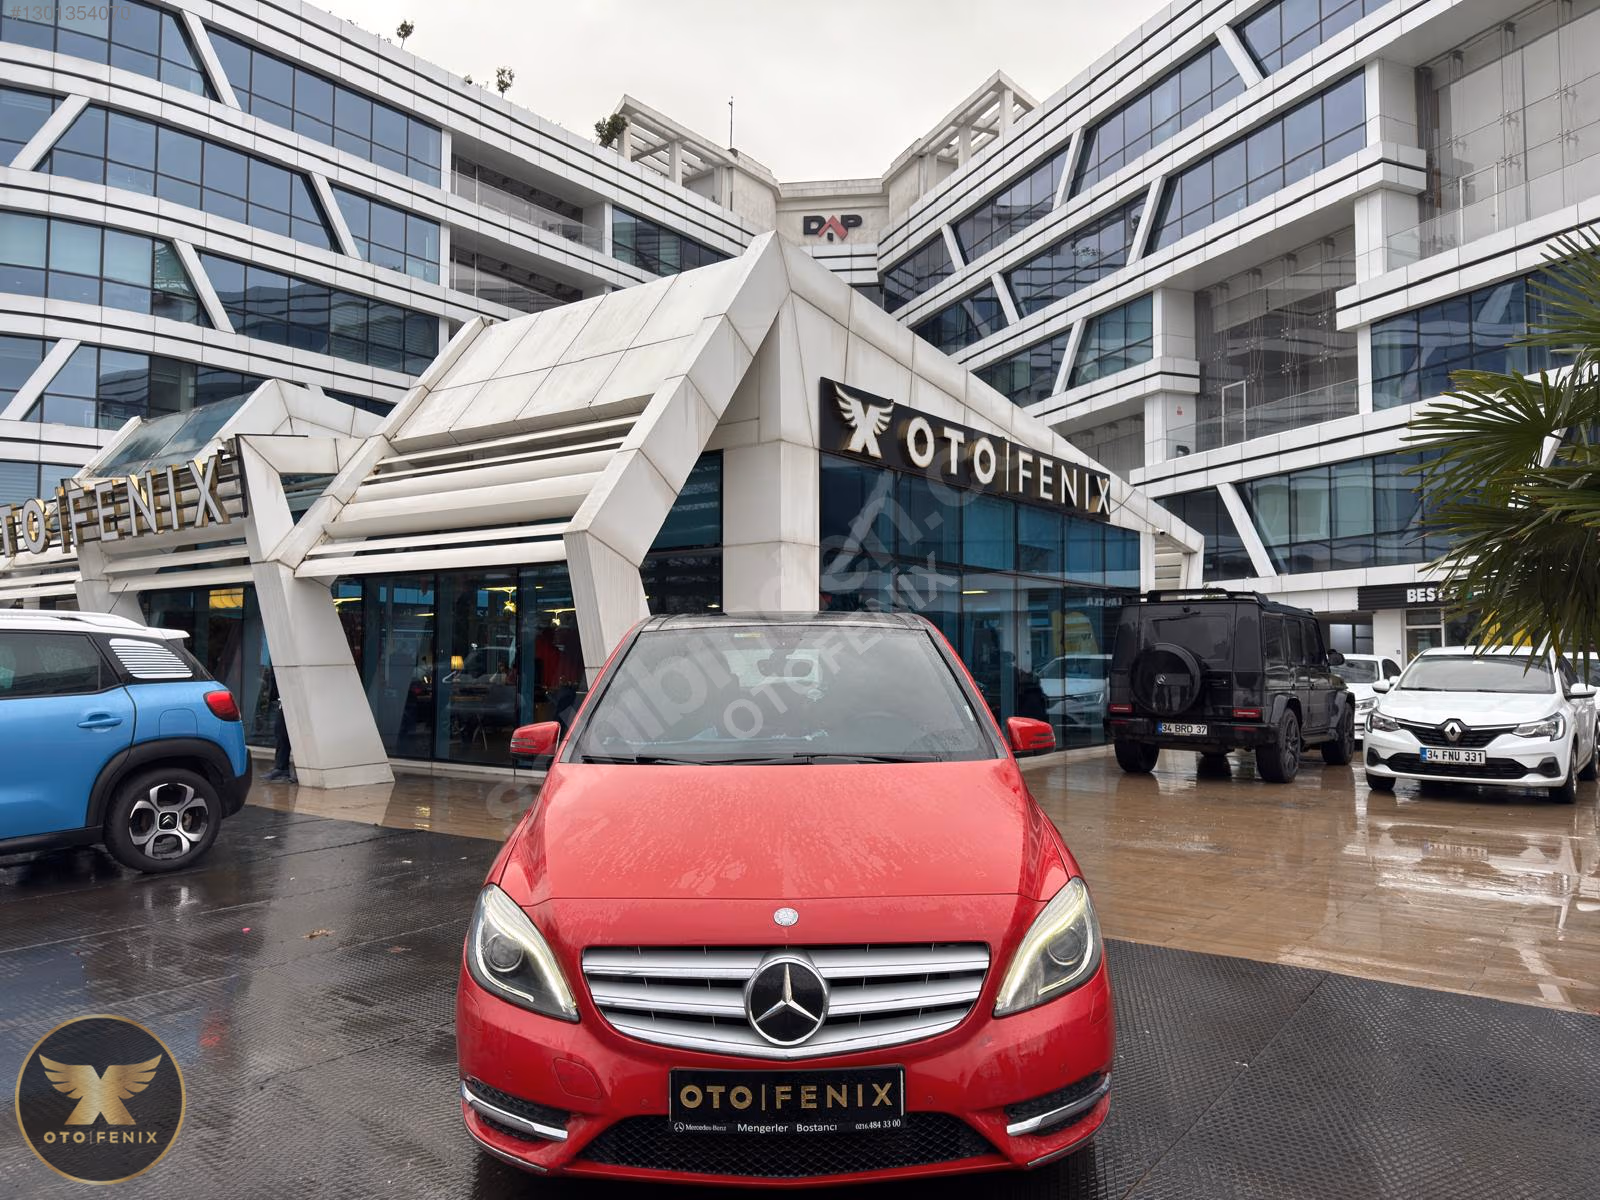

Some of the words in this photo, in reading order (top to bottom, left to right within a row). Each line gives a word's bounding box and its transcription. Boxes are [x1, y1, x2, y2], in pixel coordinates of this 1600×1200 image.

[1162, 724, 1172, 732] 34
[1197, 725, 1207, 734] 37
[1427, 750, 1438, 759] 34
[1442, 751, 1460, 761] FNU
[1464, 752, 1483, 762] 331
[737, 1123, 788, 1133] Mengerler
[796, 1123, 837, 1132] Bostancı
